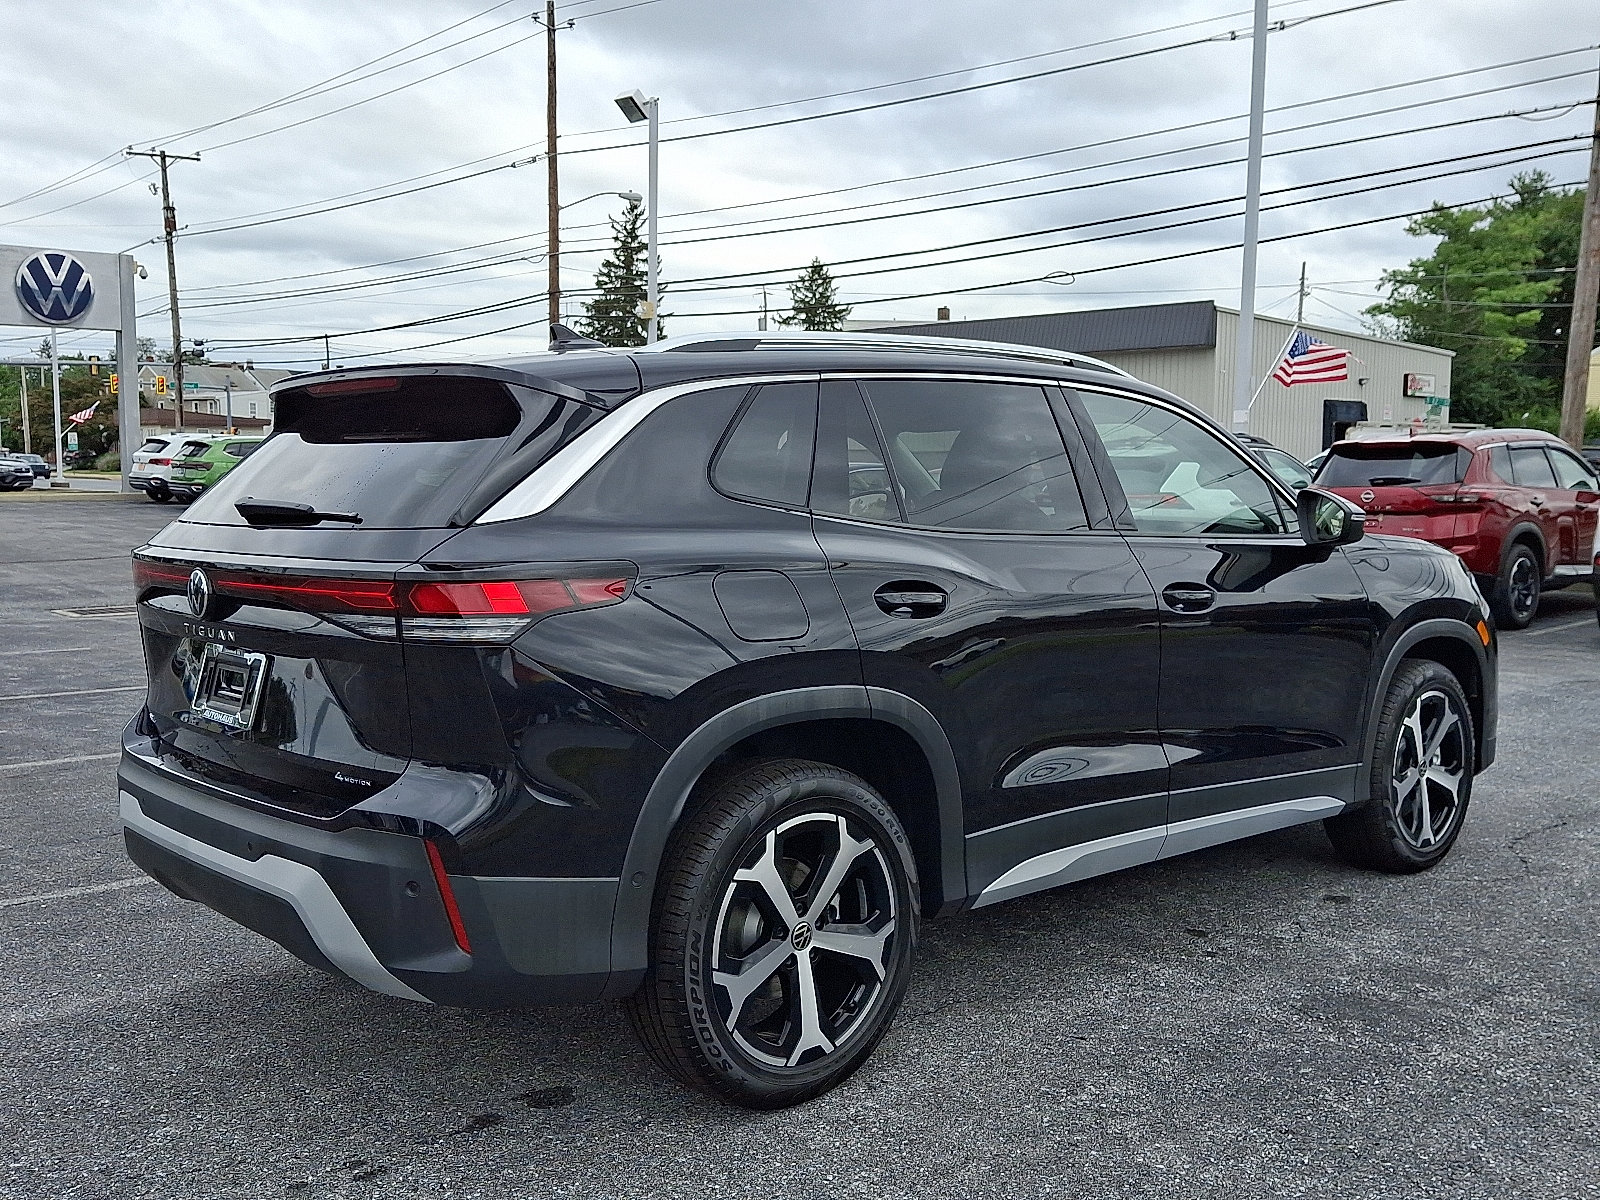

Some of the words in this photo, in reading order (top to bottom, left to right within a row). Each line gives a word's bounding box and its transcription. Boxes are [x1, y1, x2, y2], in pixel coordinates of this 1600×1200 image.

[183, 622, 236, 642] TIGUAN
[203, 709, 234, 724] AUTOHAUS
[334, 771, 372, 787] 4MOTION
[689, 928, 735, 1074] SCORPION
